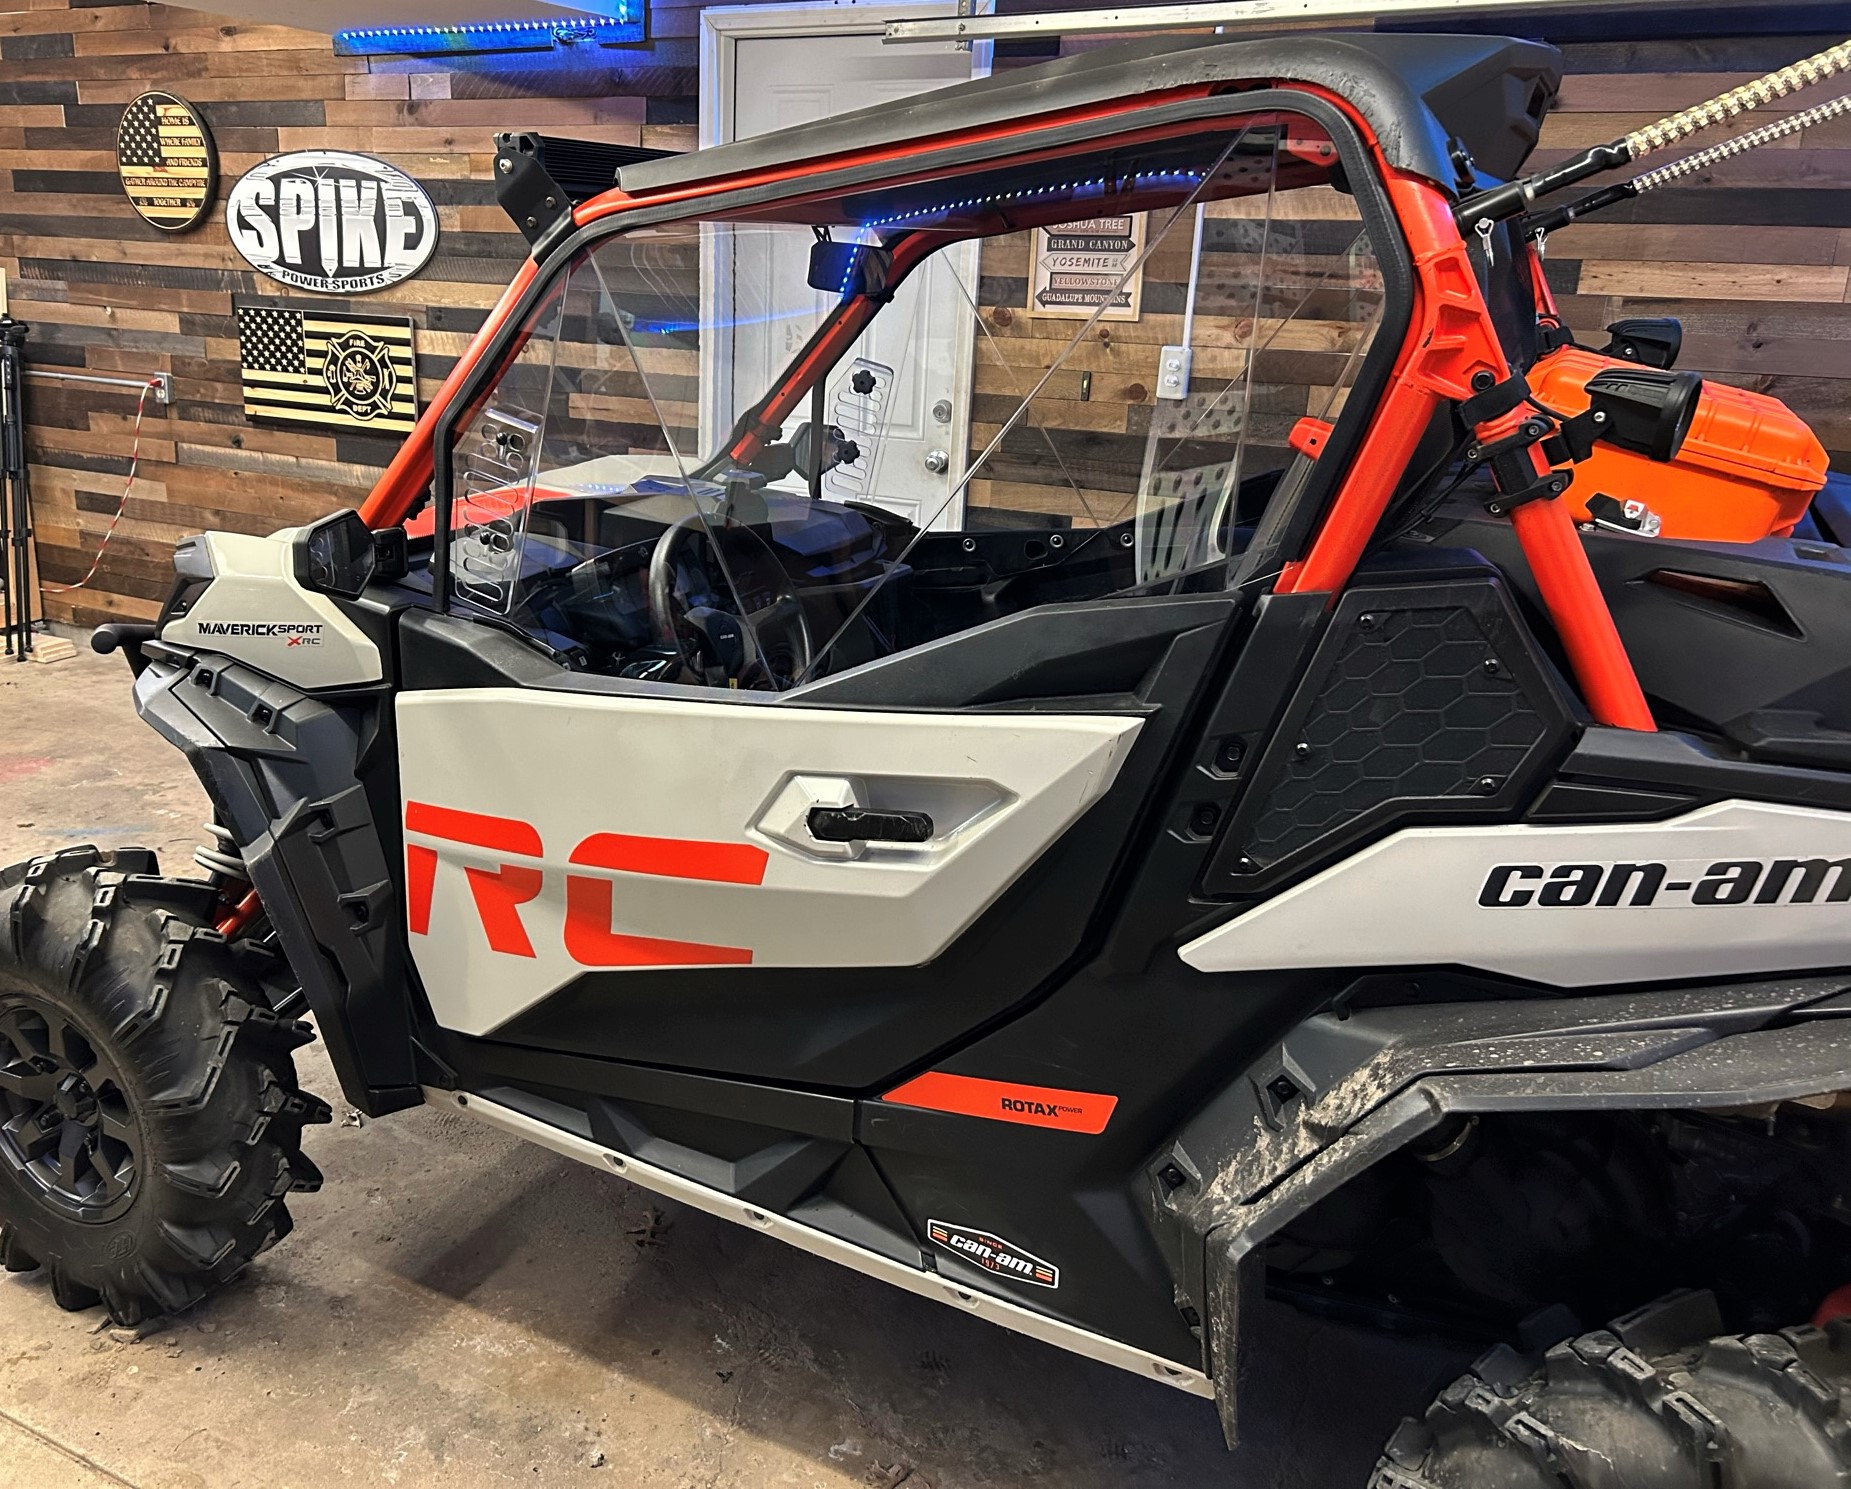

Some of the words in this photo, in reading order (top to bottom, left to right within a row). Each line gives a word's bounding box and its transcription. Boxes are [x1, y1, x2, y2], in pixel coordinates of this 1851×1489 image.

[161, 117, 182, 125] HOME
[182, 117, 190, 125] IS
[181, 138, 201, 147] FAMILY
[166, 158, 178, 166] AND
[178, 158, 203, 166] FRIENDS
[178, 178, 206, 187] CAMPFIRE
[153, 198, 181, 206] TOGETHER
[236, 176, 420, 278] SPIKE
[1100, 219, 1124, 230] TREE
[1051, 239, 1085, 249] GRAND
[1089, 240, 1128, 250] CANYON
[1052, 257, 1110, 268] YOSEMITE
[1042, 294, 1083, 302] GUADALUPE
[348, 339, 366, 347] FIRE
[352, 405, 372, 413] DEPT
[287, 636, 320, 646] XRC
[1478, 857, 1851, 907] can-am
[1001, 1097, 1059, 1118] ROTAX
[1058, 1105, 1083, 1114] POWER
[949, 1234, 1032, 1276] can-am
[981, 1258, 1000, 1270] 1973
